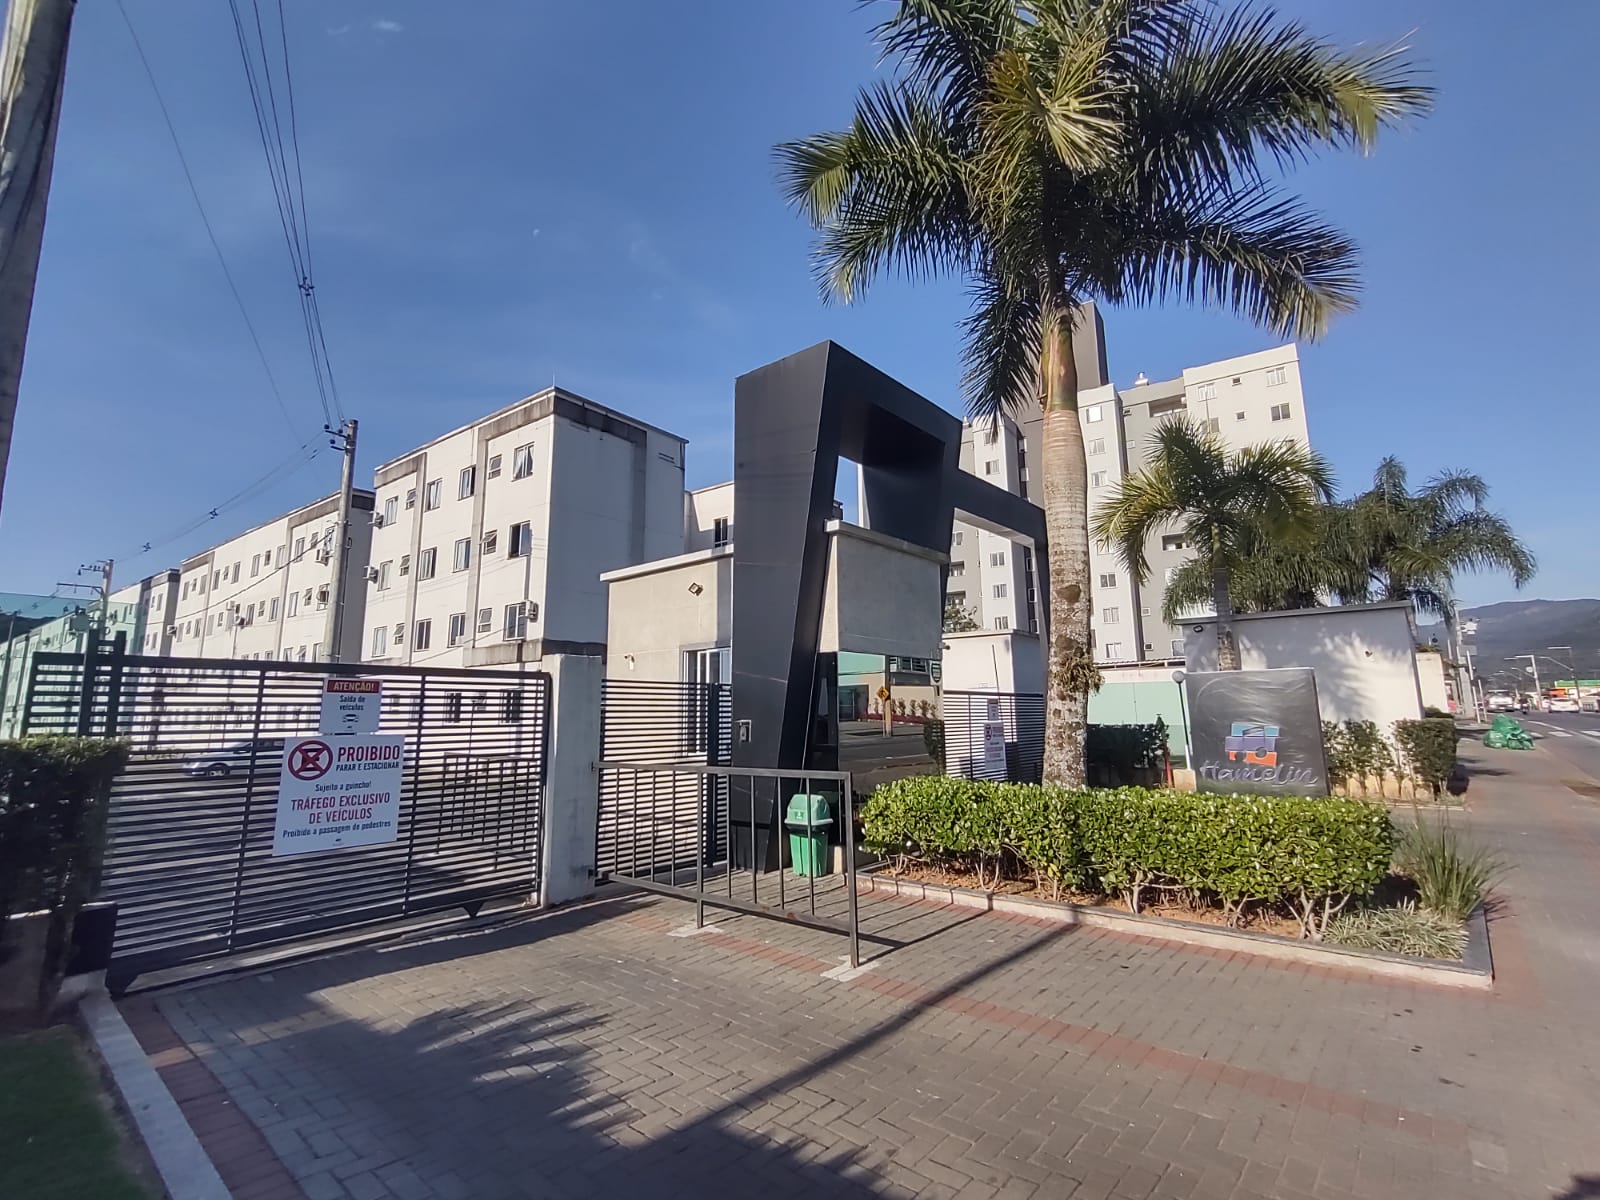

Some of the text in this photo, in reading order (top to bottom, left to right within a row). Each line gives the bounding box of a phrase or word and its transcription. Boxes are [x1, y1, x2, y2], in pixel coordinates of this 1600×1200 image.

[337, 745, 400, 763] PROIBIDO
[336, 761, 400, 772] PARAR E ESTACIONAR
[315, 782, 338, 793] Sujeito
[345, 780, 372, 792] guincho!
[291, 792, 390, 811] TRÁFEGO EXCLUSIVO
[309, 807, 372, 825] DE VEÍCULOS
[282, 829, 311, 838] Proibido
[318, 825, 351, 836] passagem
[352, 822, 360, 831] de
[361, 820, 391, 832] pedestres
